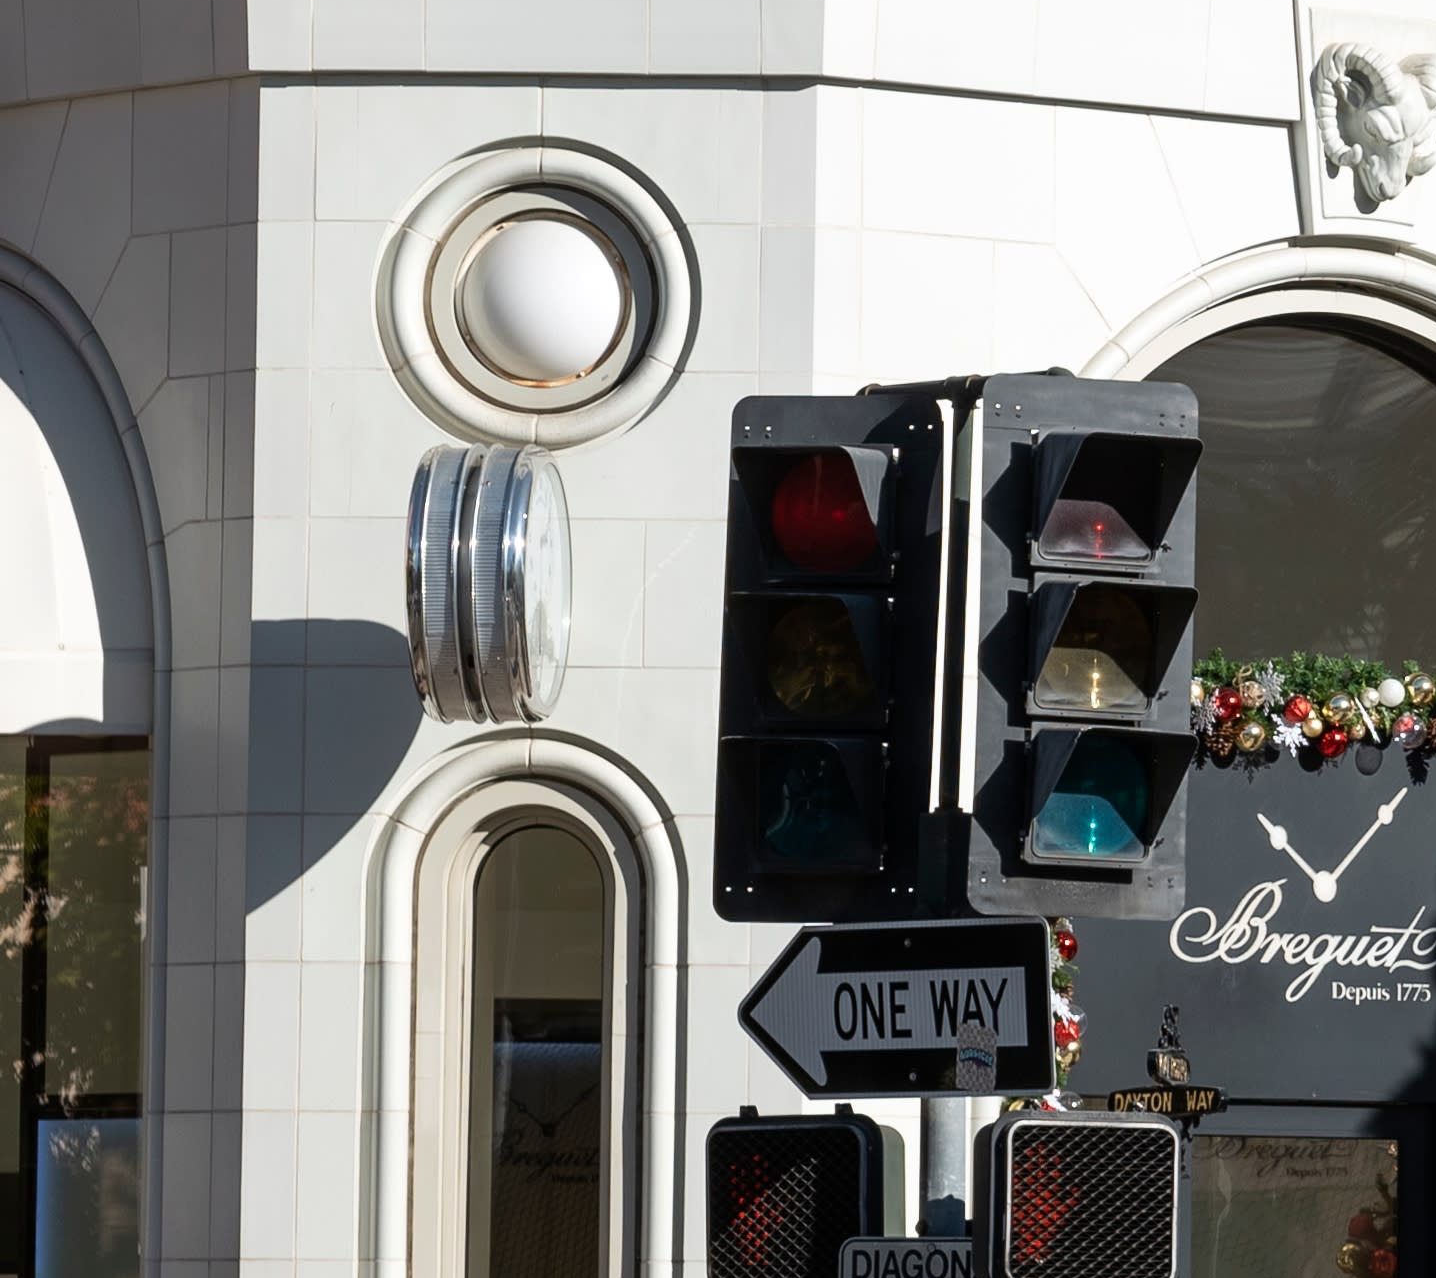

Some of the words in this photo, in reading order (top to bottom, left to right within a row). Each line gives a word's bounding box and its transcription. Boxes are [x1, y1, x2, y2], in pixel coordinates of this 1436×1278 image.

[1331, 981, 1391, 1005] Depuis
[1396, 982, 1432, 1002] 1775
[833, 979, 913, 1041] ONE
[929, 977, 1008, 1037] WAY
[1185, 1089, 1216, 1112] WAY
